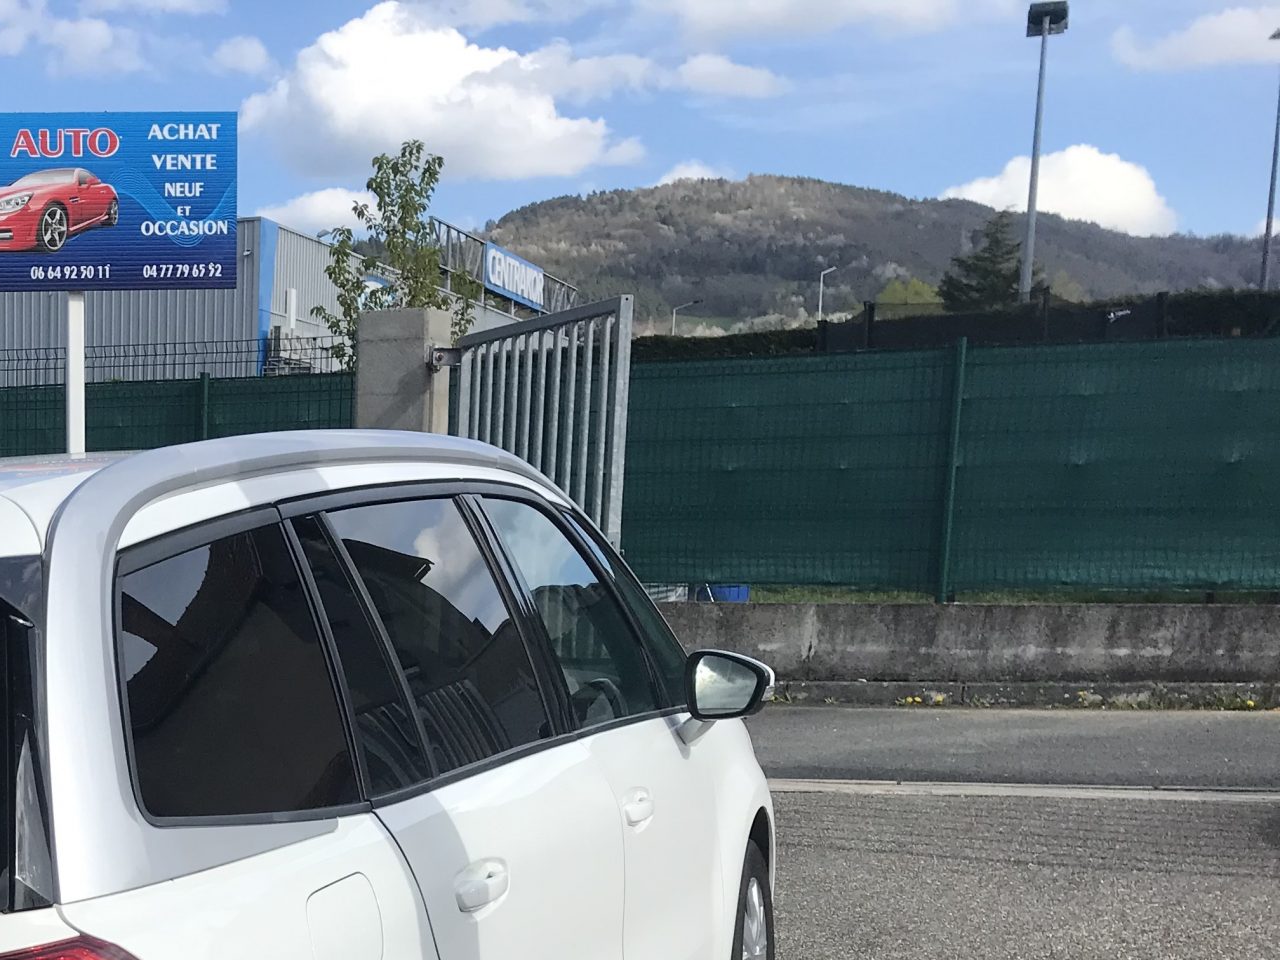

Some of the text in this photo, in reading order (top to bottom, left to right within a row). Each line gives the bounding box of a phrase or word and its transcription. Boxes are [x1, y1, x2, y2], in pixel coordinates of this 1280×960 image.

[147, 123, 221, 140] ACHAT
[10, 128, 120, 158] AUTO
[151, 154, 217, 170] VENTE
[164, 182, 204, 197] NEUF
[176, 206, 192, 216] ET
[140, 220, 228, 236] OCCASION
